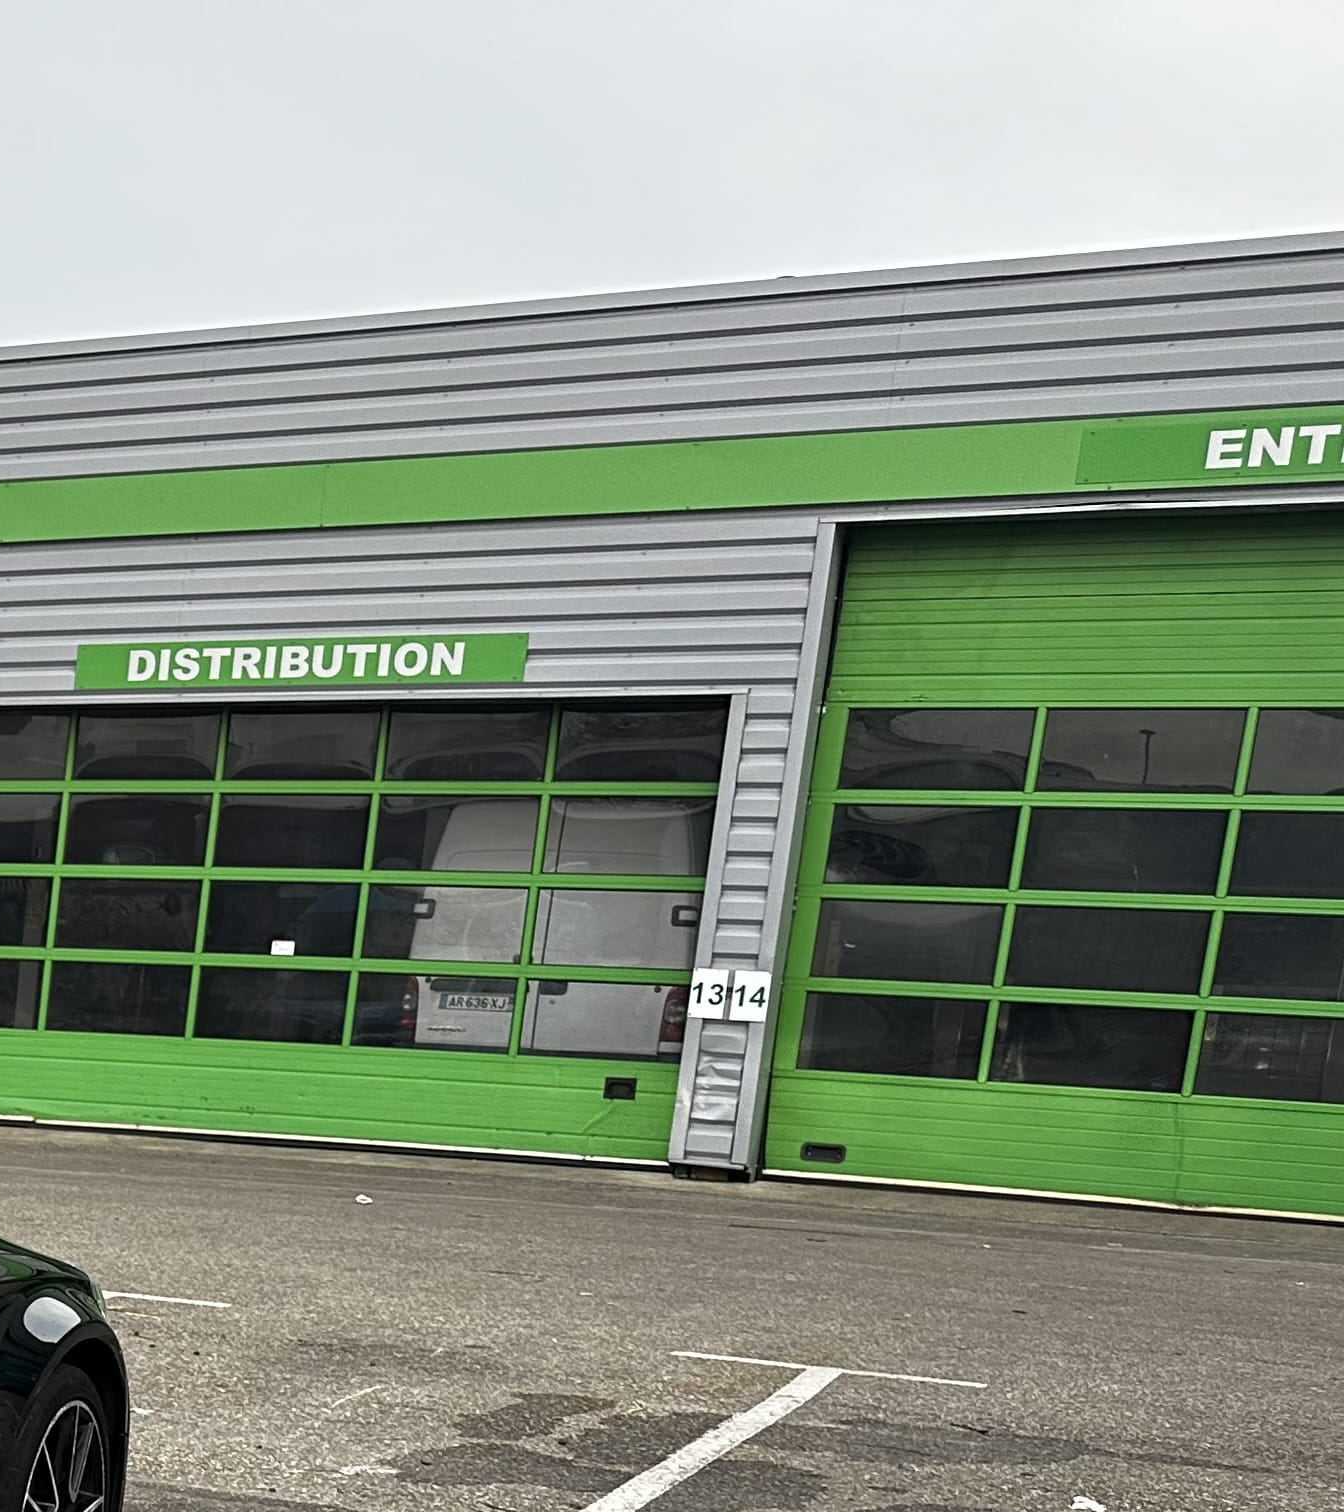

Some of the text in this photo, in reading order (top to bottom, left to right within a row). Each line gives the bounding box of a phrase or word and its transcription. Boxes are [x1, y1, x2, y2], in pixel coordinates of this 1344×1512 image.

[1204, 424, 1344, 470] ENT
[127, 642, 465, 682] DISTRIBUTION
[692, 982, 724, 1005] 13
[734, 984, 766, 1007] 14
